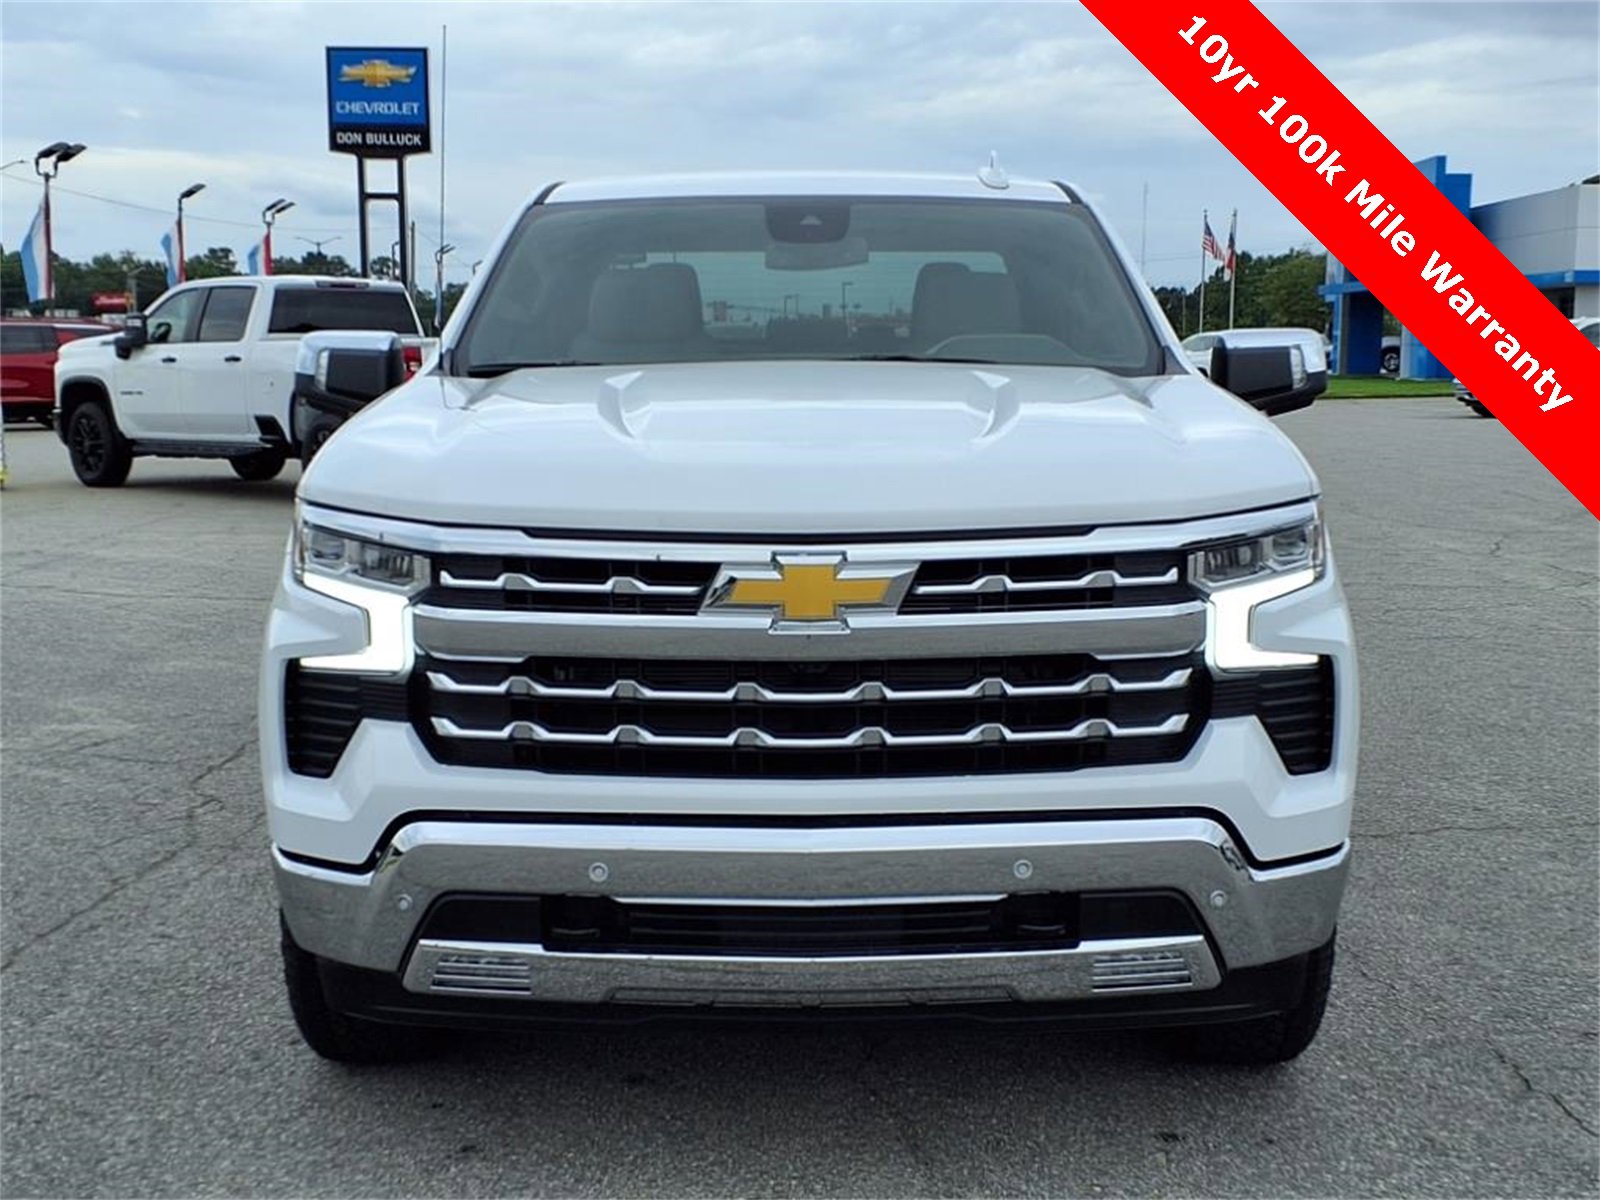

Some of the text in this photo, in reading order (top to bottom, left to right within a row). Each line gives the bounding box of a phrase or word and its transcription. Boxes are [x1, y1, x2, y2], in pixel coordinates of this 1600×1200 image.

[335, 100, 420, 115] CHEVROLET
[336, 132, 422, 146] DON BULLUCK
